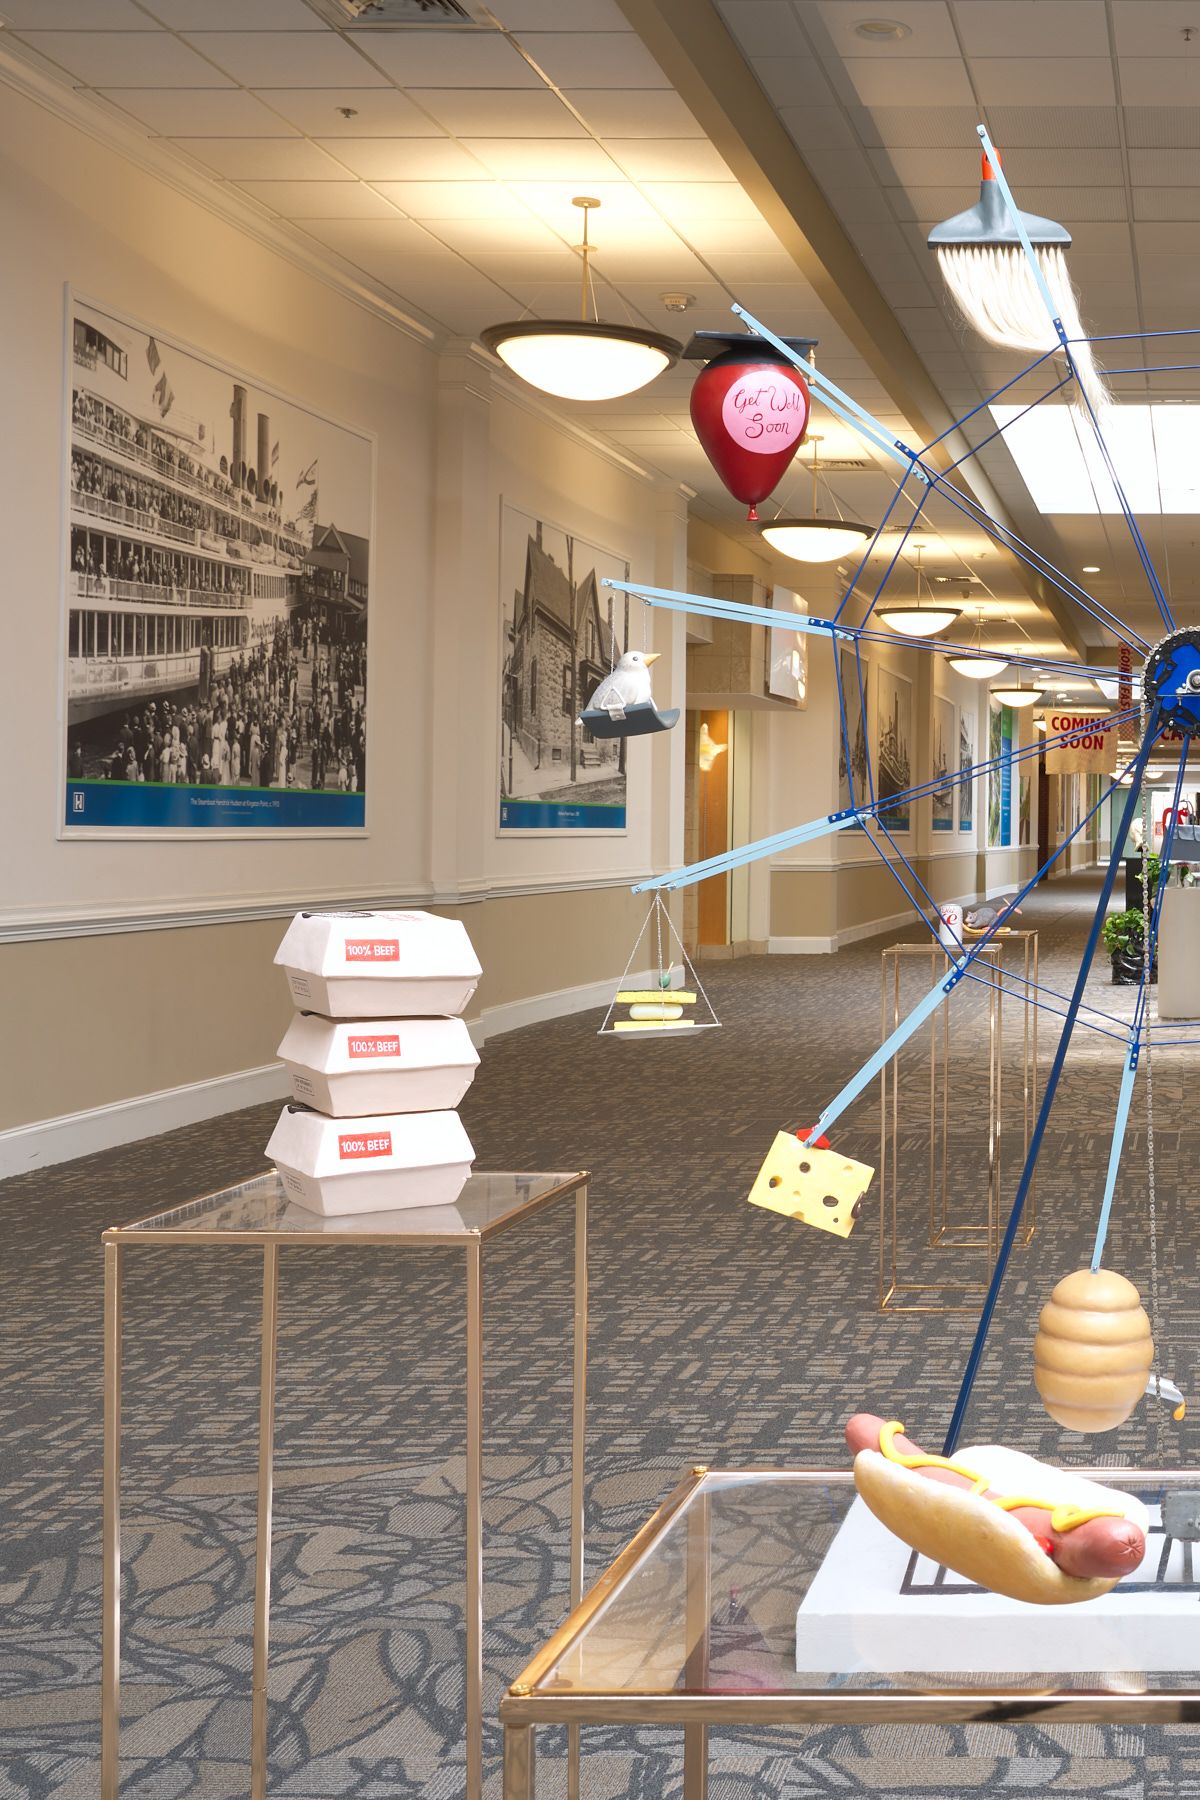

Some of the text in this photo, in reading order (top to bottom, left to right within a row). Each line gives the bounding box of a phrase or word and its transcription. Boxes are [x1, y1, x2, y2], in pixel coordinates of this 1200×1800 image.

[734, 385, 801, 414] Get Well
[745, 413, 791, 439] Soon
[1120, 648, 1131, 682] GOING
[1051, 716, 1111, 732] COMING
[1059, 735, 1104, 750] SOON
[347, 944, 396, 956] 100% BEEF
[351, 1040, 398, 1053] 100% BEEF
[340, 1138, 390, 1153] 100% BEEF
